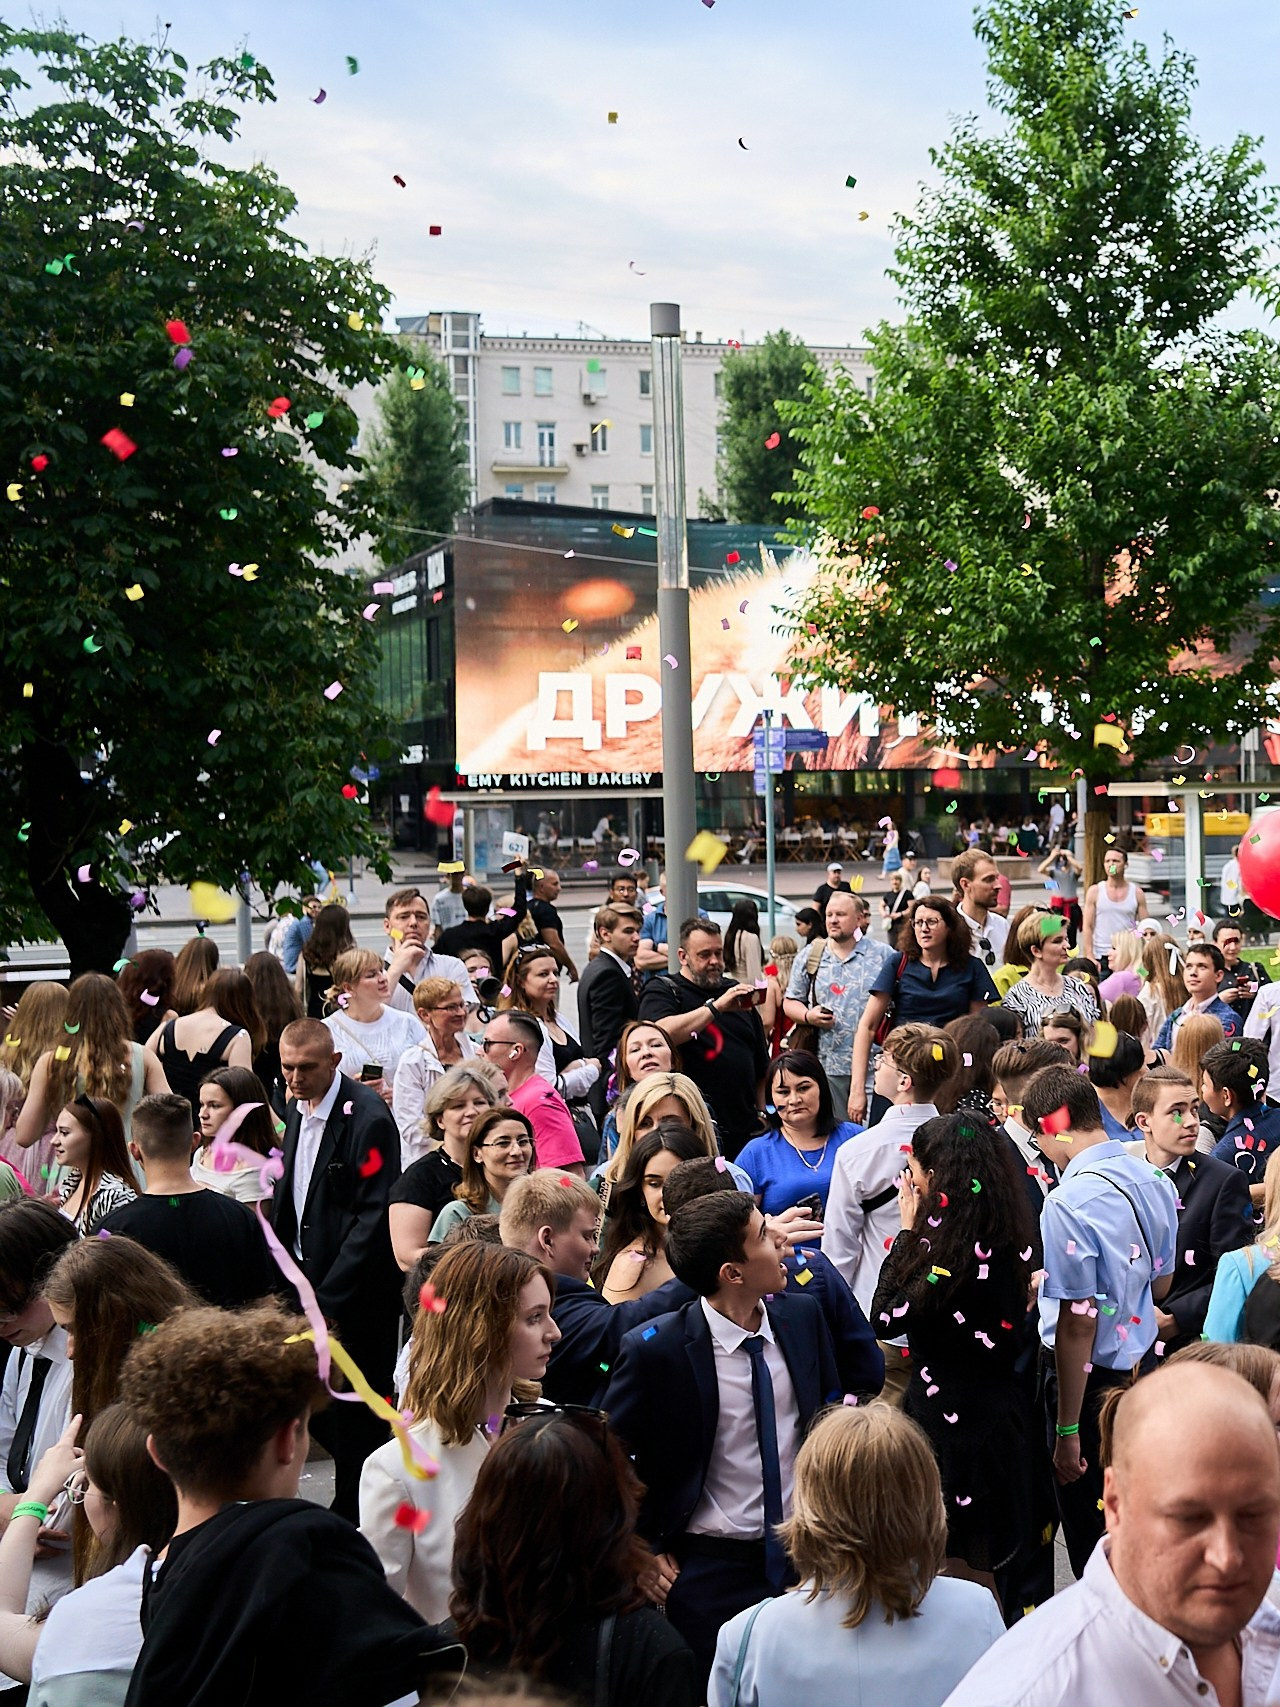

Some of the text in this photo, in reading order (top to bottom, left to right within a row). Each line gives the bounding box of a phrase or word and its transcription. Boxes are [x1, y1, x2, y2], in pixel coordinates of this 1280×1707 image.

[456, 771, 652, 788] REMY KITCHEN BAKERY
